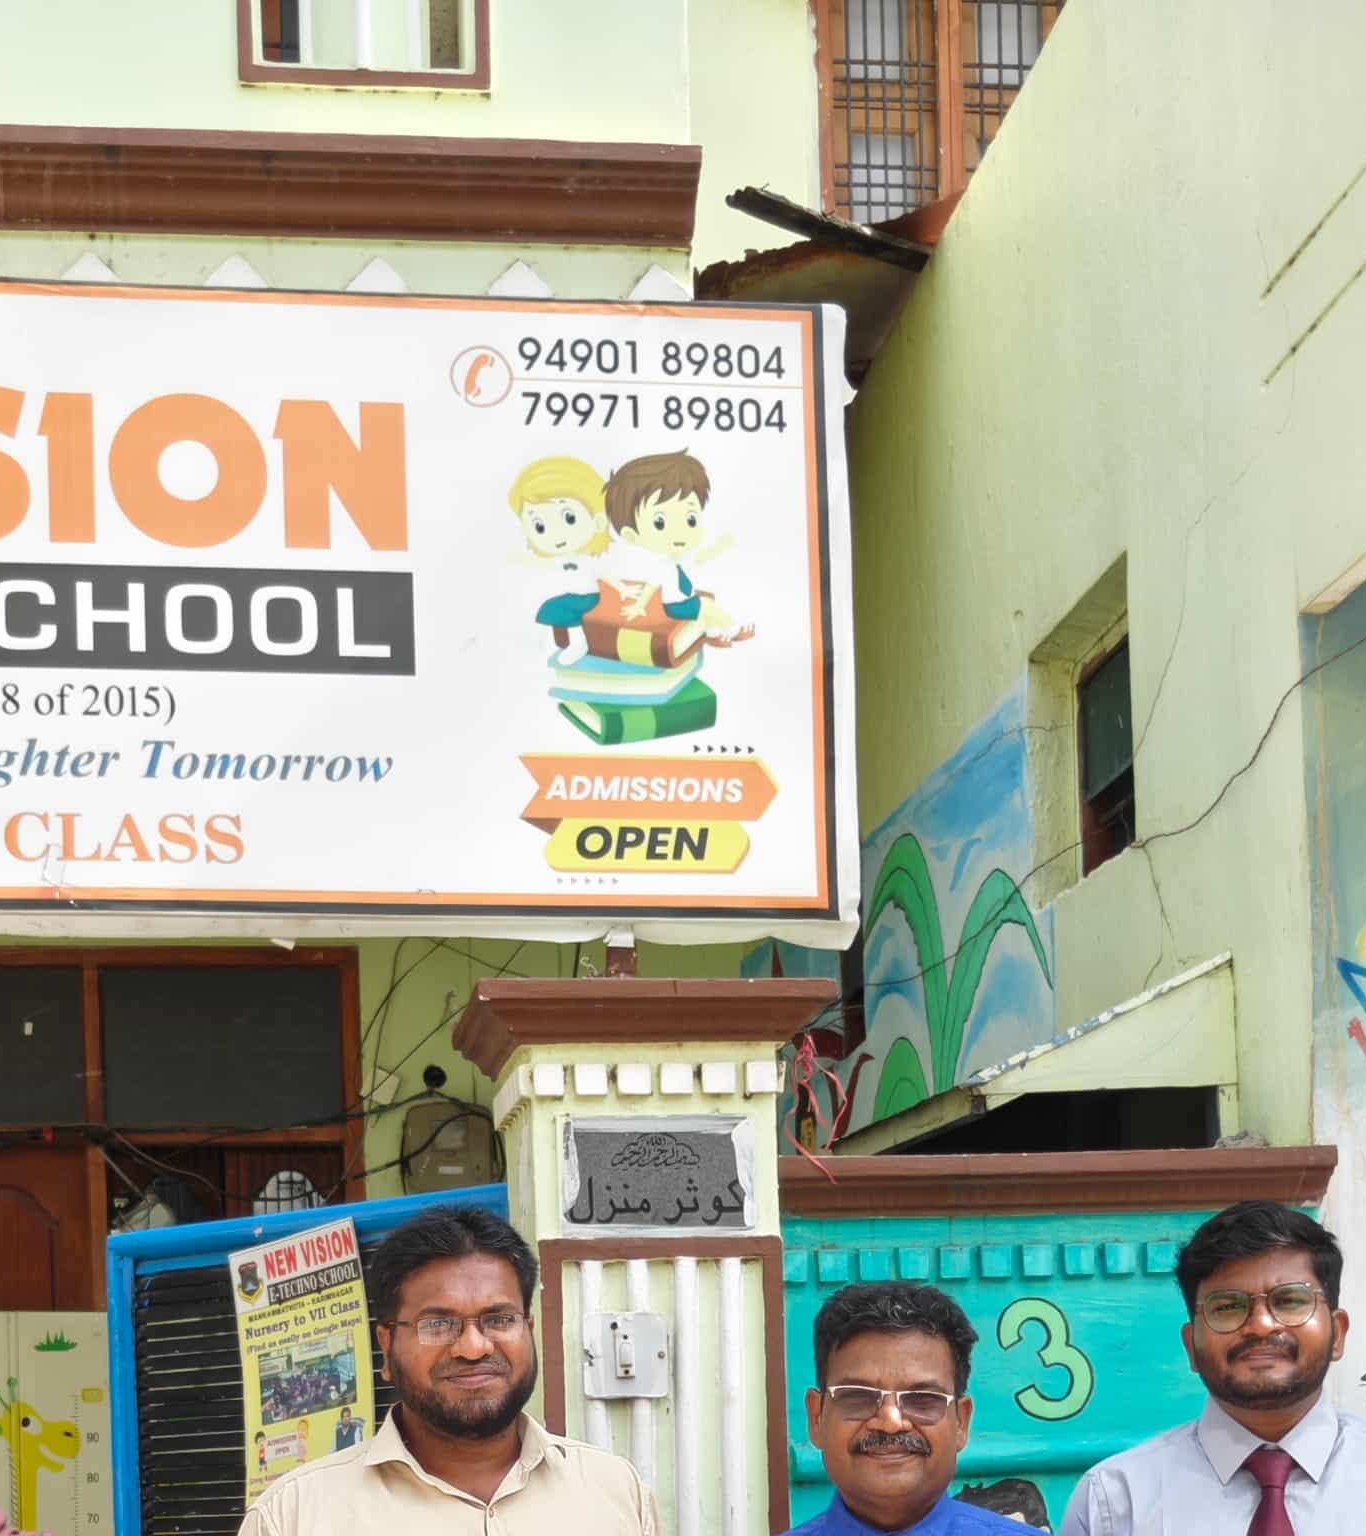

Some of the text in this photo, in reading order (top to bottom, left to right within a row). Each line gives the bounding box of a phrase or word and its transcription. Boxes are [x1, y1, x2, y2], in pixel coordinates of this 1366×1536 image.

[518, 335, 785, 380] 94901 89804
[522, 391, 786, 433] 79971 89804
[35, 683, 73, 715] of
[82, 684, 177, 725] 2015)
[141, 740, 394, 782] Tomorrow
[545, 773, 744, 803] ADMISSIONS
[4, 811, 245, 865] CLASS
[575, 825, 709, 861] OPEN
[263, 1227, 355, 1280] NEW VISION
[269, 1263, 358, 1302] E-TECHNO SCHOOL
[245, 1300, 360, 1341] Nursery to VII Class
[996, 1297, 1095, 1422] 3
[86, 1432, 101, 1443] 90
[86, 1472, 101, 1484] 80
[86, 1513, 101, 1524] 70
